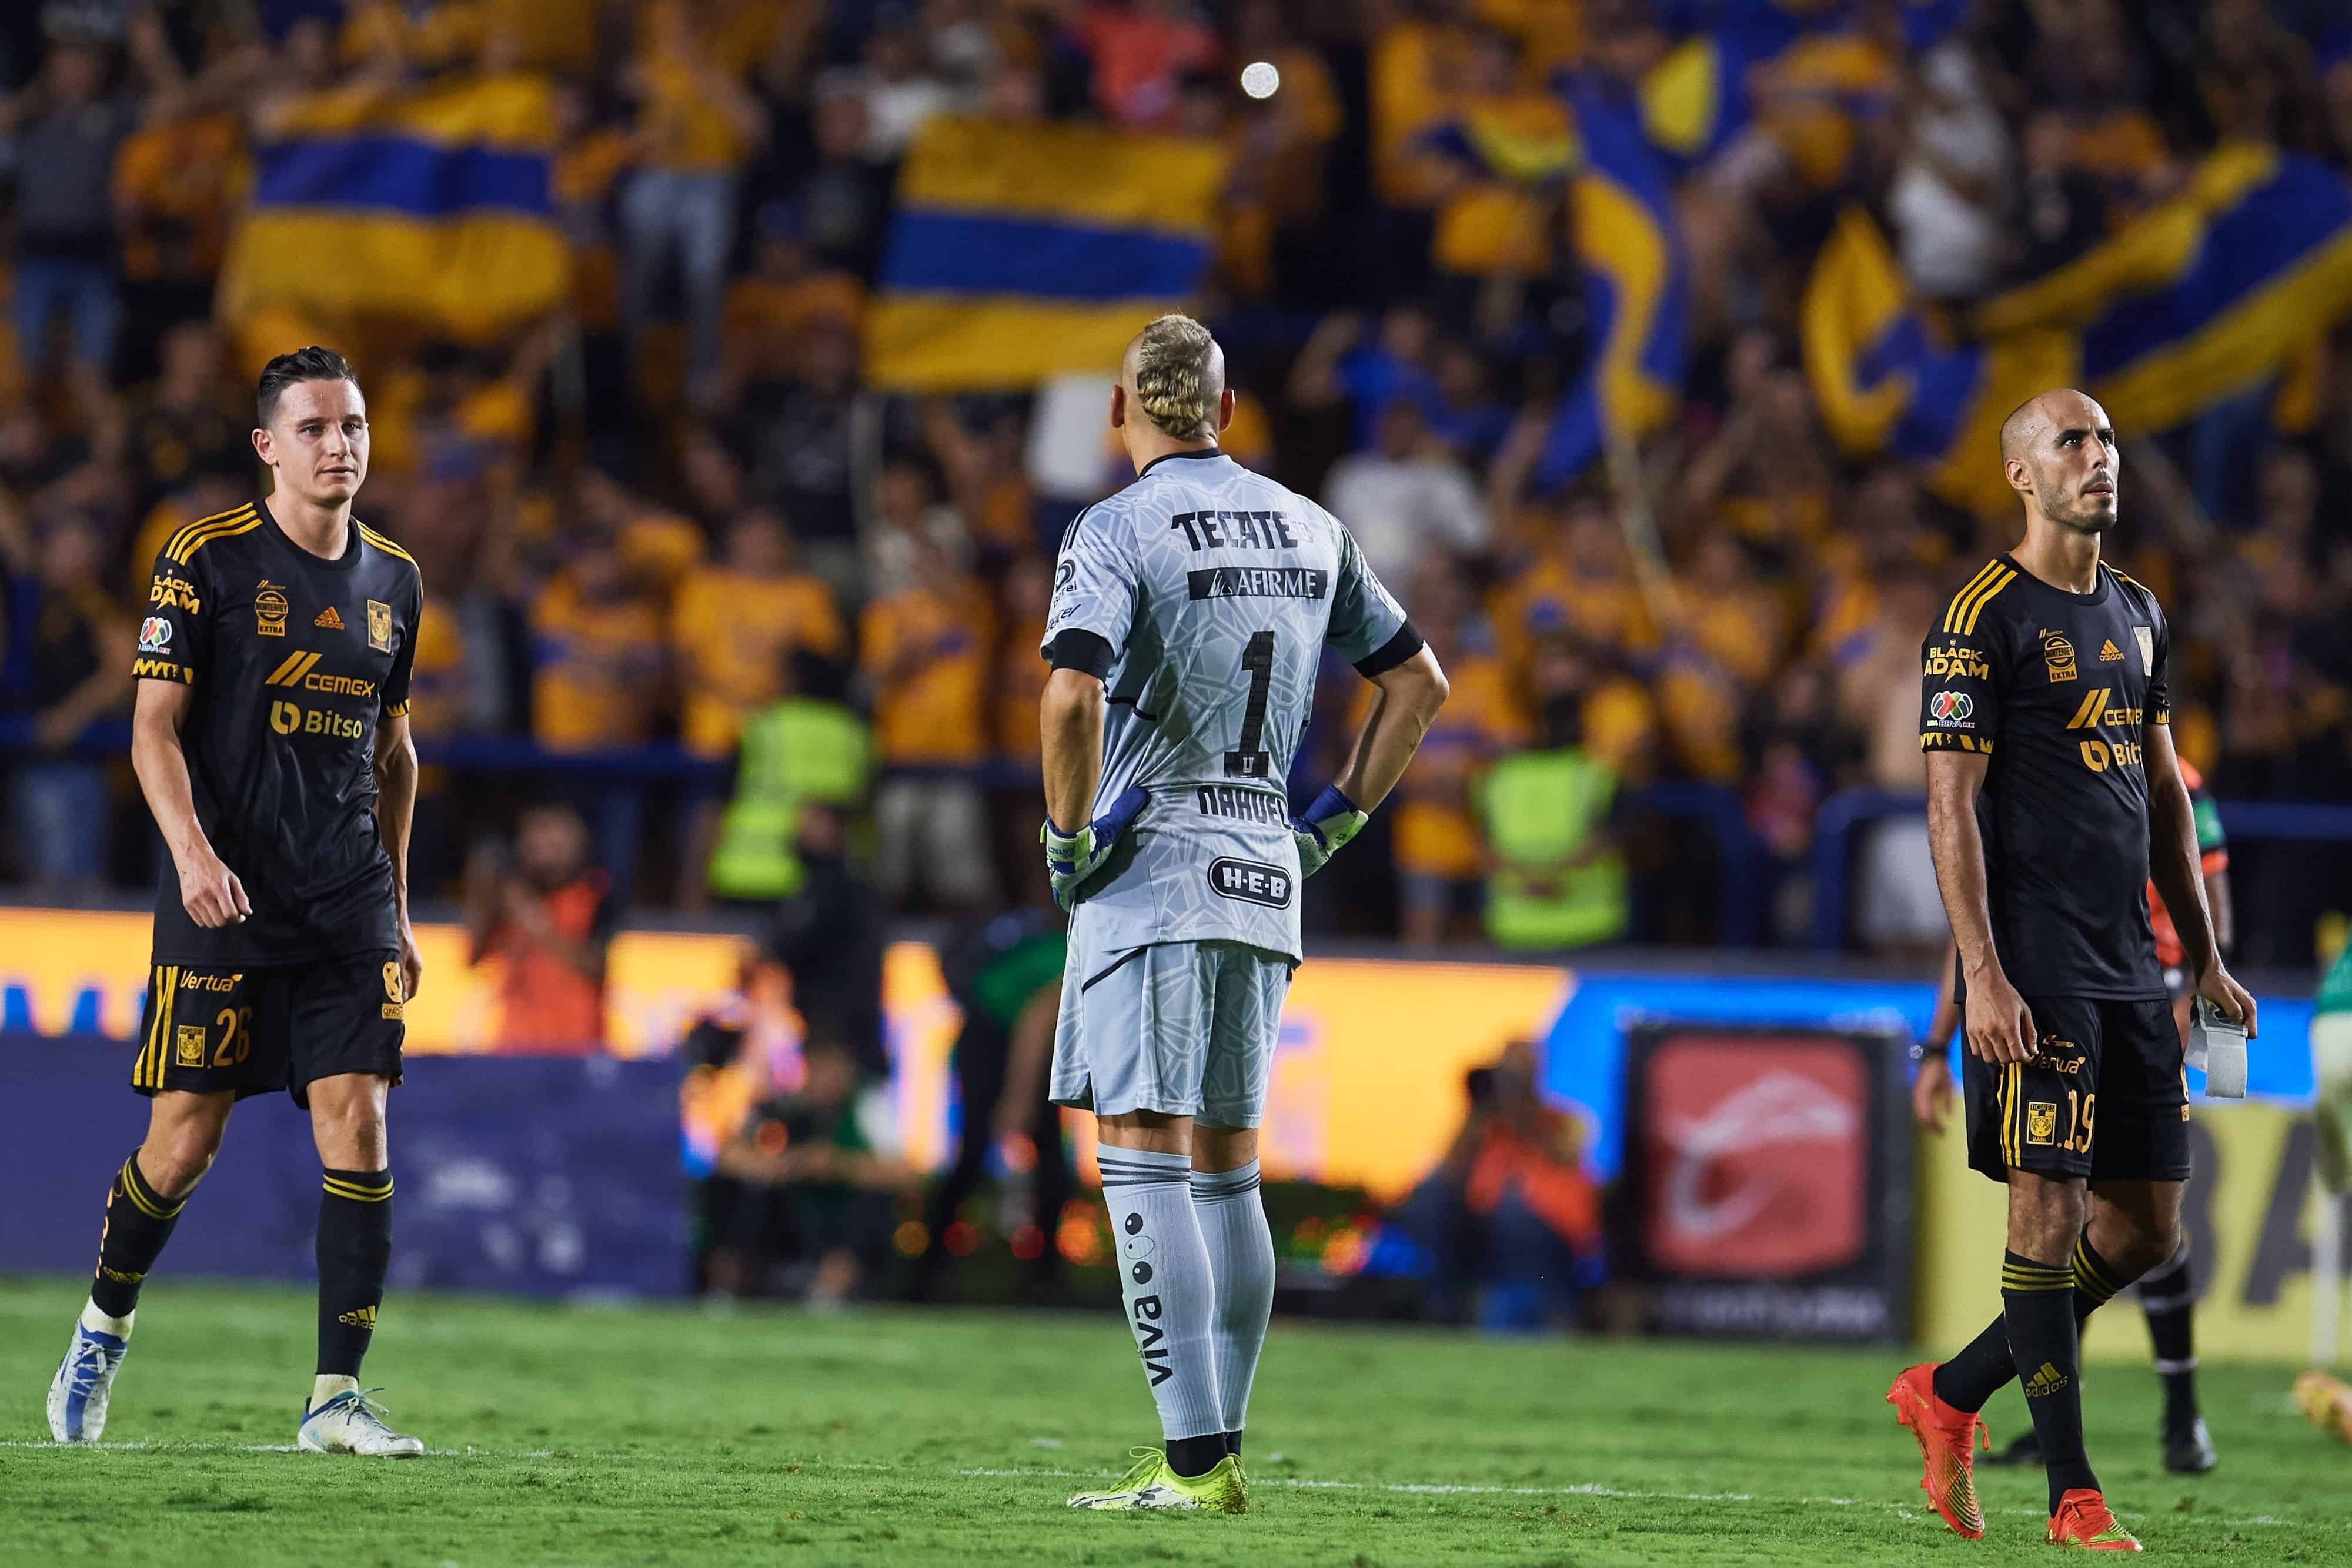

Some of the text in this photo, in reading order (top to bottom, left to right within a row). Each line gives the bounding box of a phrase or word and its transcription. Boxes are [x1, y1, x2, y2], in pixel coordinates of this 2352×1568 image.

[1171, 510, 1298, 551] TECATE
[154, 575, 195, 596] LACK
[1237, 570, 1317, 597] AFIRME
[150, 585, 200, 615] DAM
[259, 625, 283, 634] EXTRA
[1930, 647, 1983, 662] BLACK
[2099, 652, 2125, 661] adidas
[1923, 658, 1989, 684] ADAM
[2052, 670, 2076, 680] EXTRA
[305, 673, 375, 697] CEMEX
[1224, 631, 1275, 778] 1
[304, 710, 363, 739] Bitso
[180, 970, 235, 992] Vertua
[213, 1006, 253, 1067] 26
[2064, 1089, 2096, 1154] 19
[1134, 1295, 1174, 1387] viva
[2026, 1376, 2068, 1398] adidas
